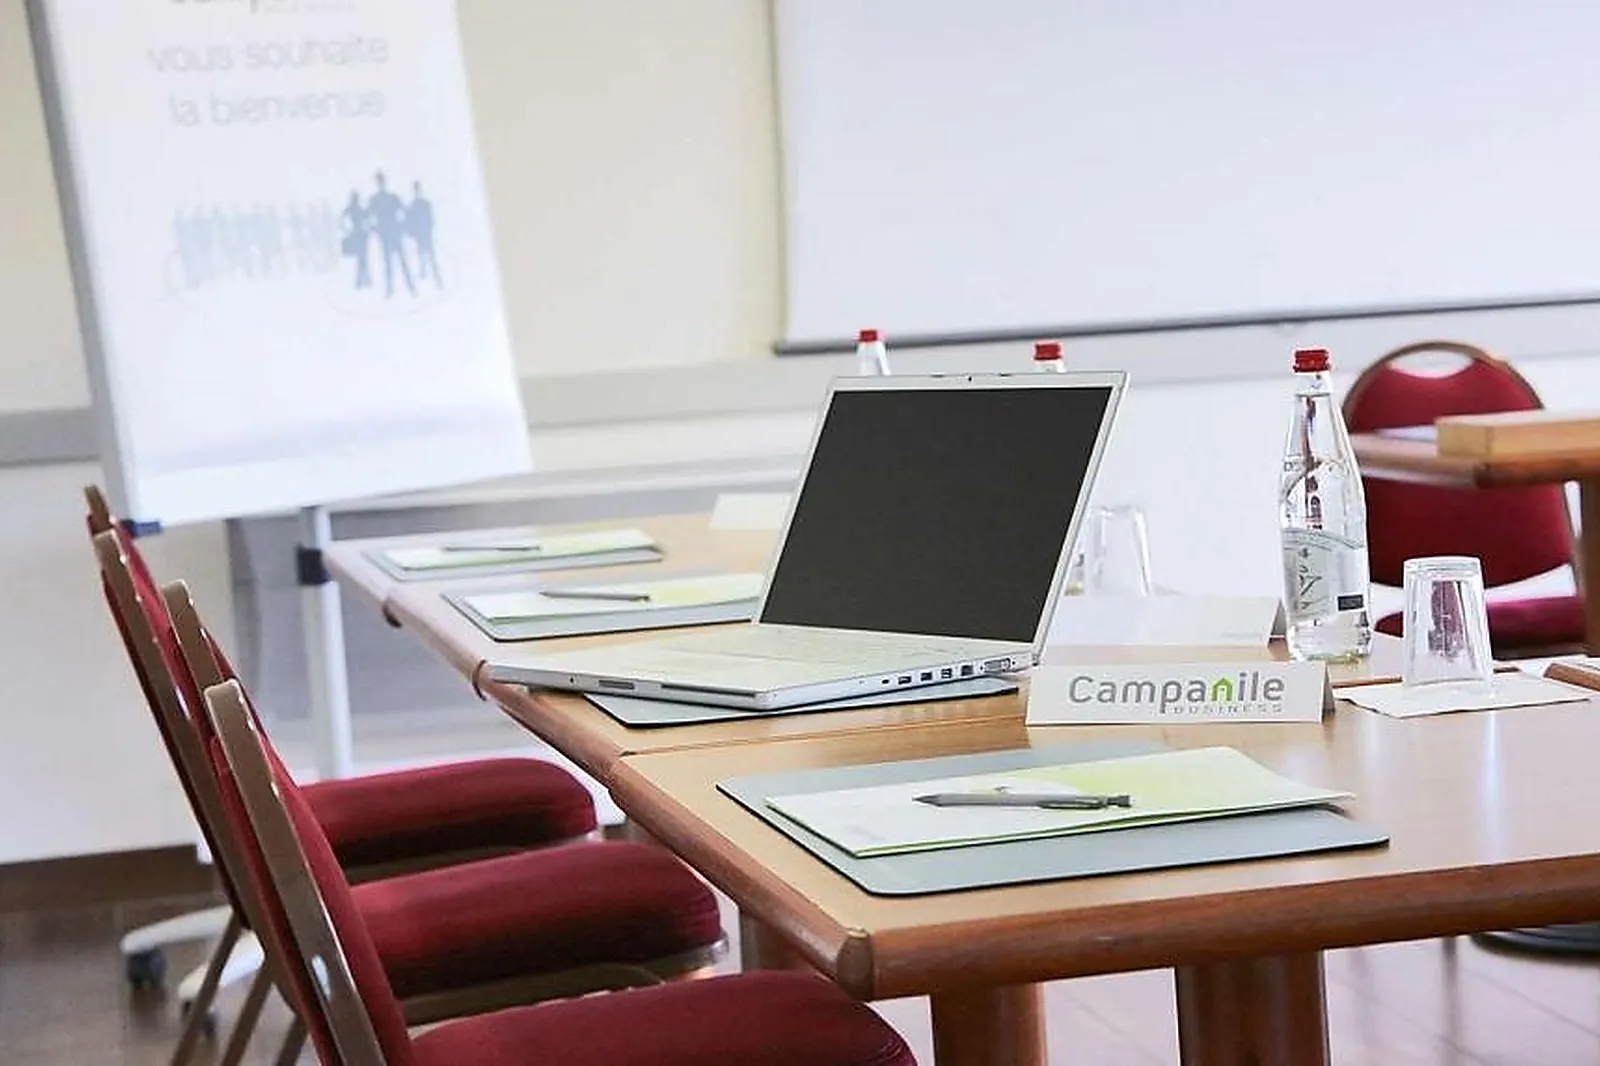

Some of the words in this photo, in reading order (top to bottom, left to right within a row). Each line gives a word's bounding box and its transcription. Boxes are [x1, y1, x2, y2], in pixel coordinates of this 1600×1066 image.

[147, 44, 234, 72] vous
[245, 34, 390, 70] souhaite
[169, 93, 201, 127] la
[209, 89, 386, 125] bienvenue
[1068, 671, 1286, 714] Campanile
